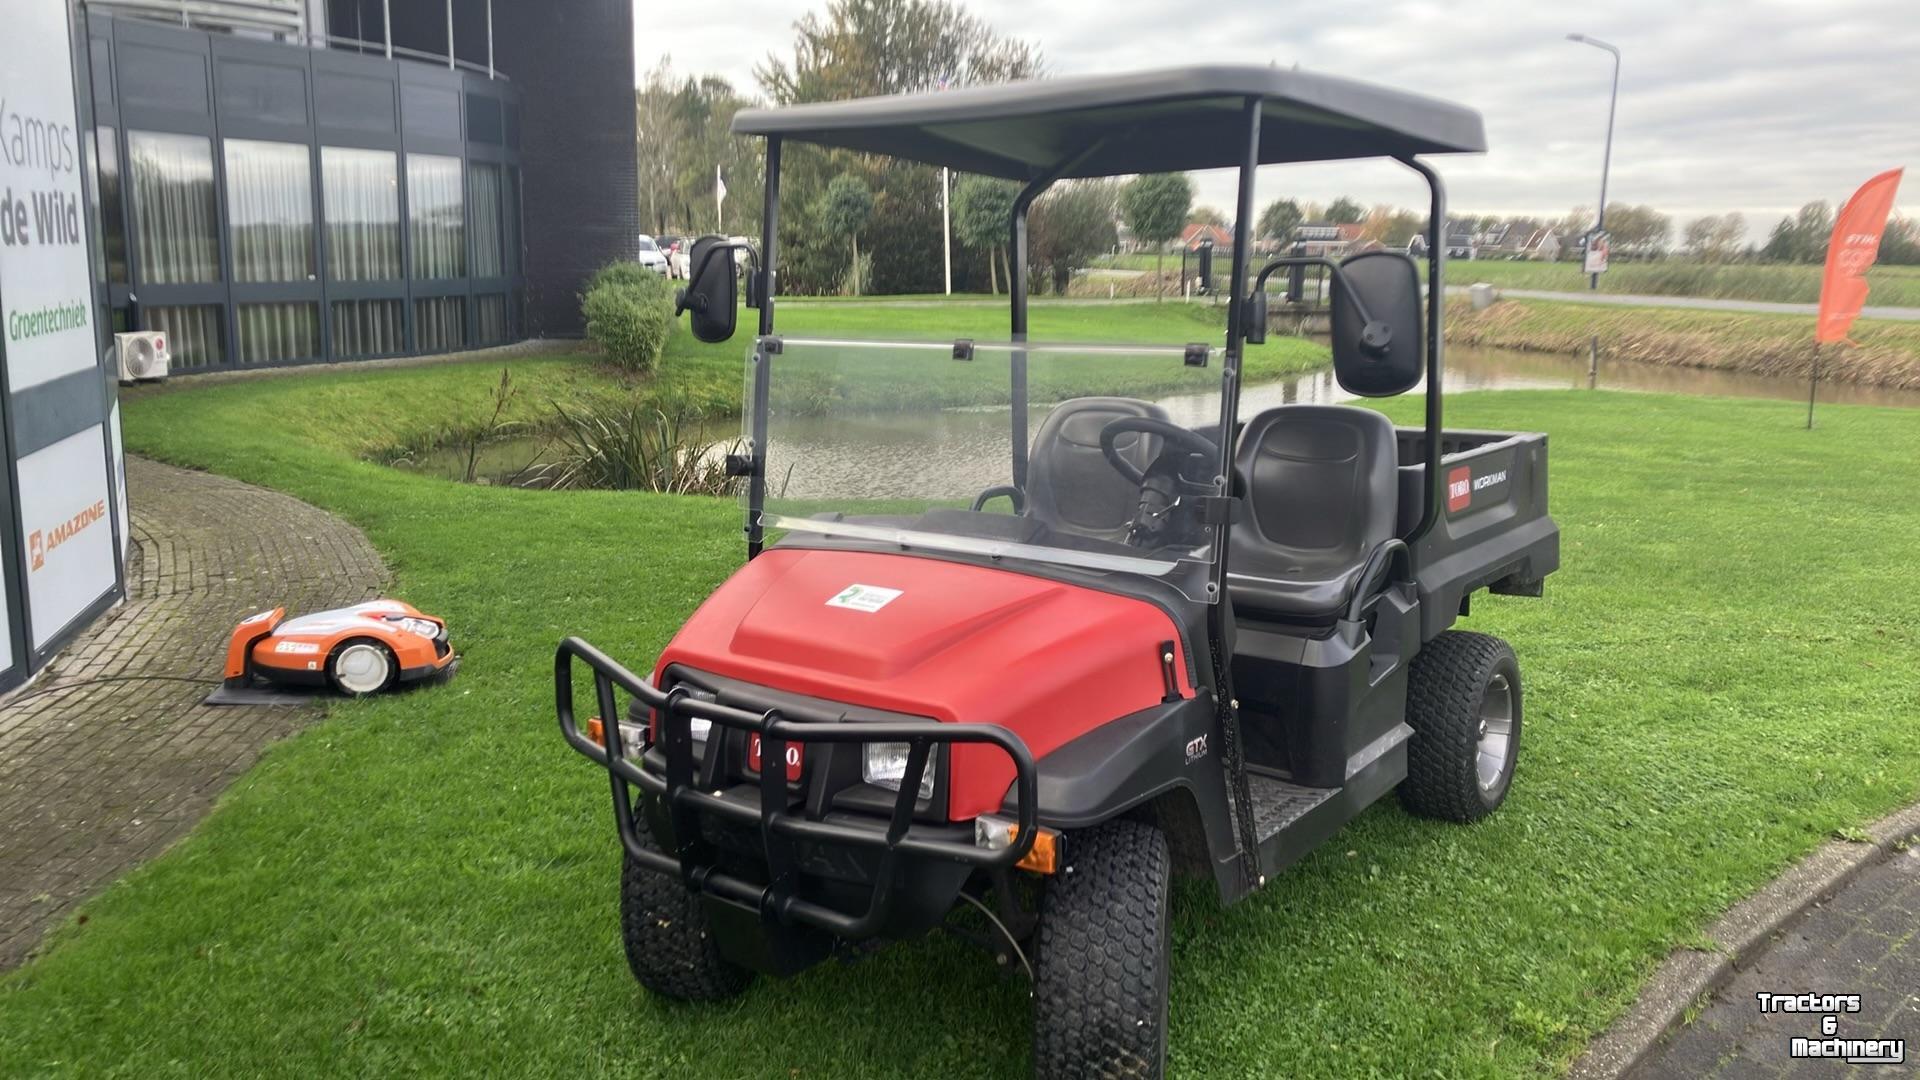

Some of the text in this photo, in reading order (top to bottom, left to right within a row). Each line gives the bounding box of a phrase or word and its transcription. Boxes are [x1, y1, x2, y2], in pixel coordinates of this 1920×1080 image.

[0, 187, 79, 246] de Wild
[9, 301, 87, 341] Groentechniek
[1448, 469, 1507, 499] TORO WORKMAN
[46, 498, 105, 552] AMAZONE
[754, 738, 799, 765] TO
[1186, 733, 1207, 757] GTX
